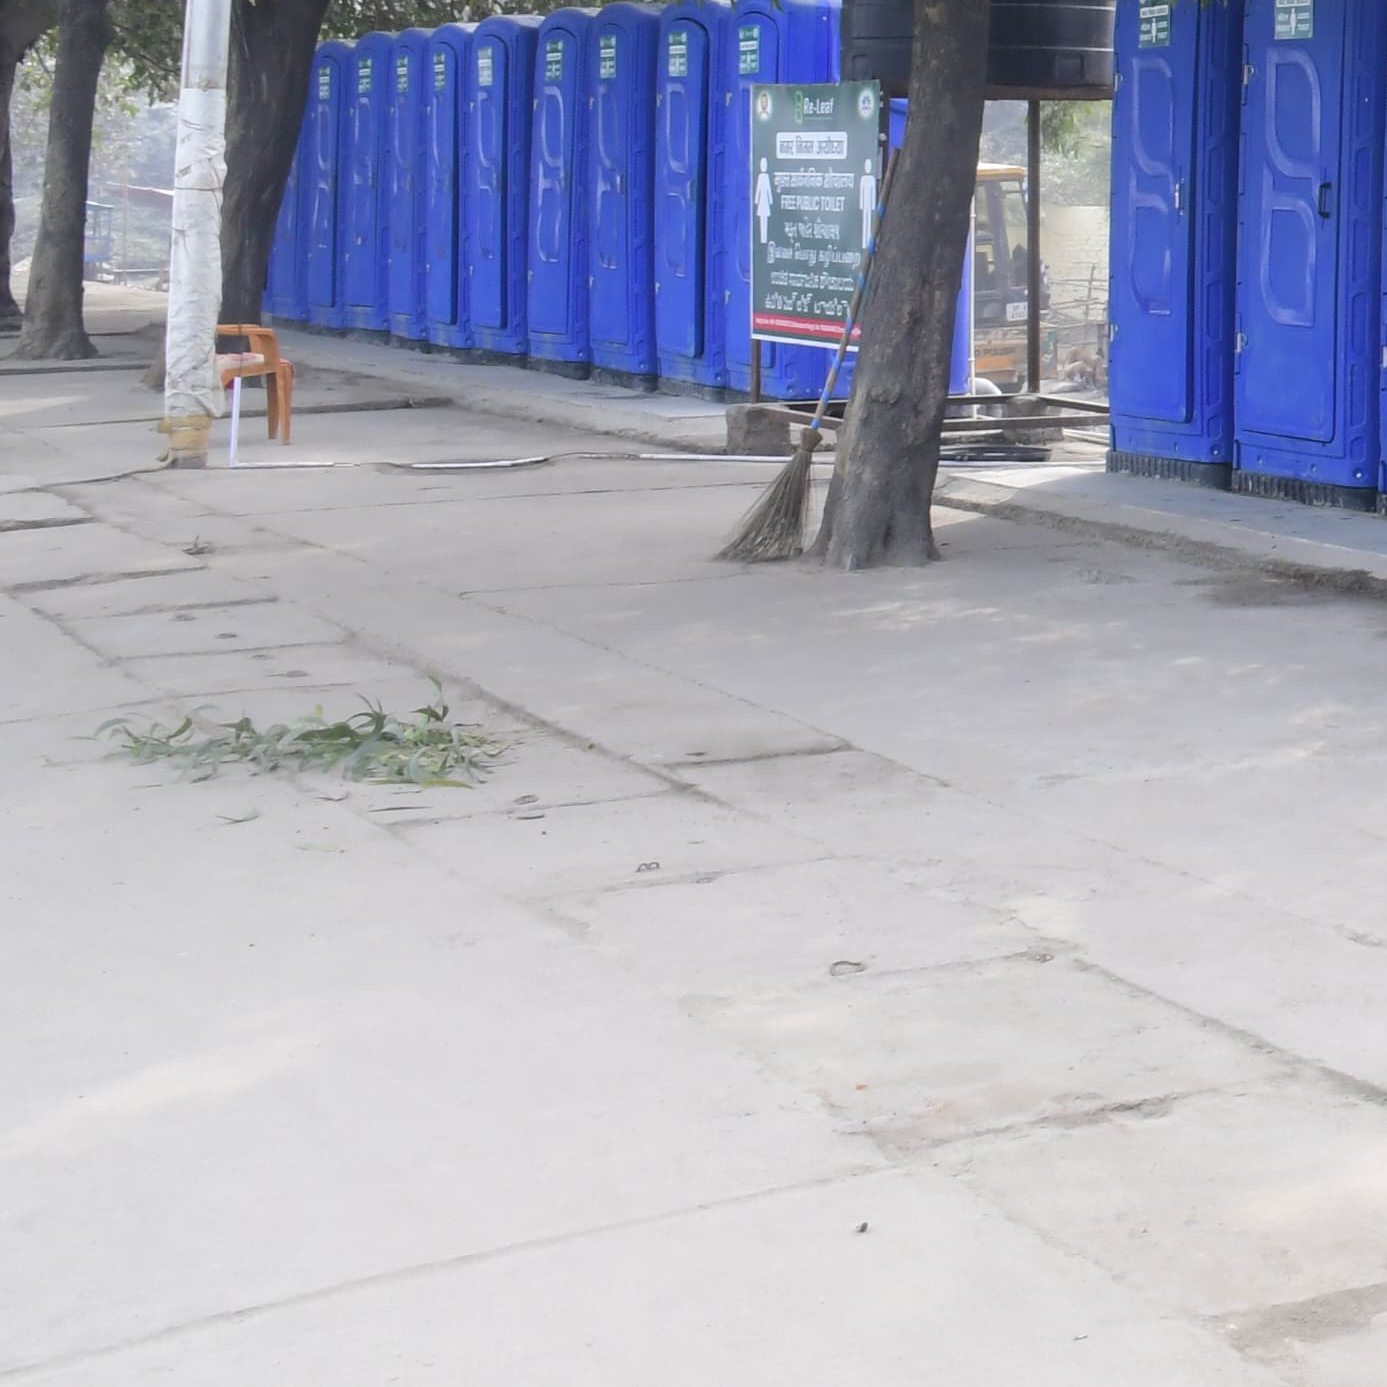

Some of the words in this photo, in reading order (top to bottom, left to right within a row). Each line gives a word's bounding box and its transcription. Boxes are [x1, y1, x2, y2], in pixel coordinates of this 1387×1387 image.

[803, 97, 834, 114] Re-Leaf
[780, 195, 797, 210] FREE
[797, 195, 820, 211] PUBLIC
[820, 196, 846, 212] TOILET
